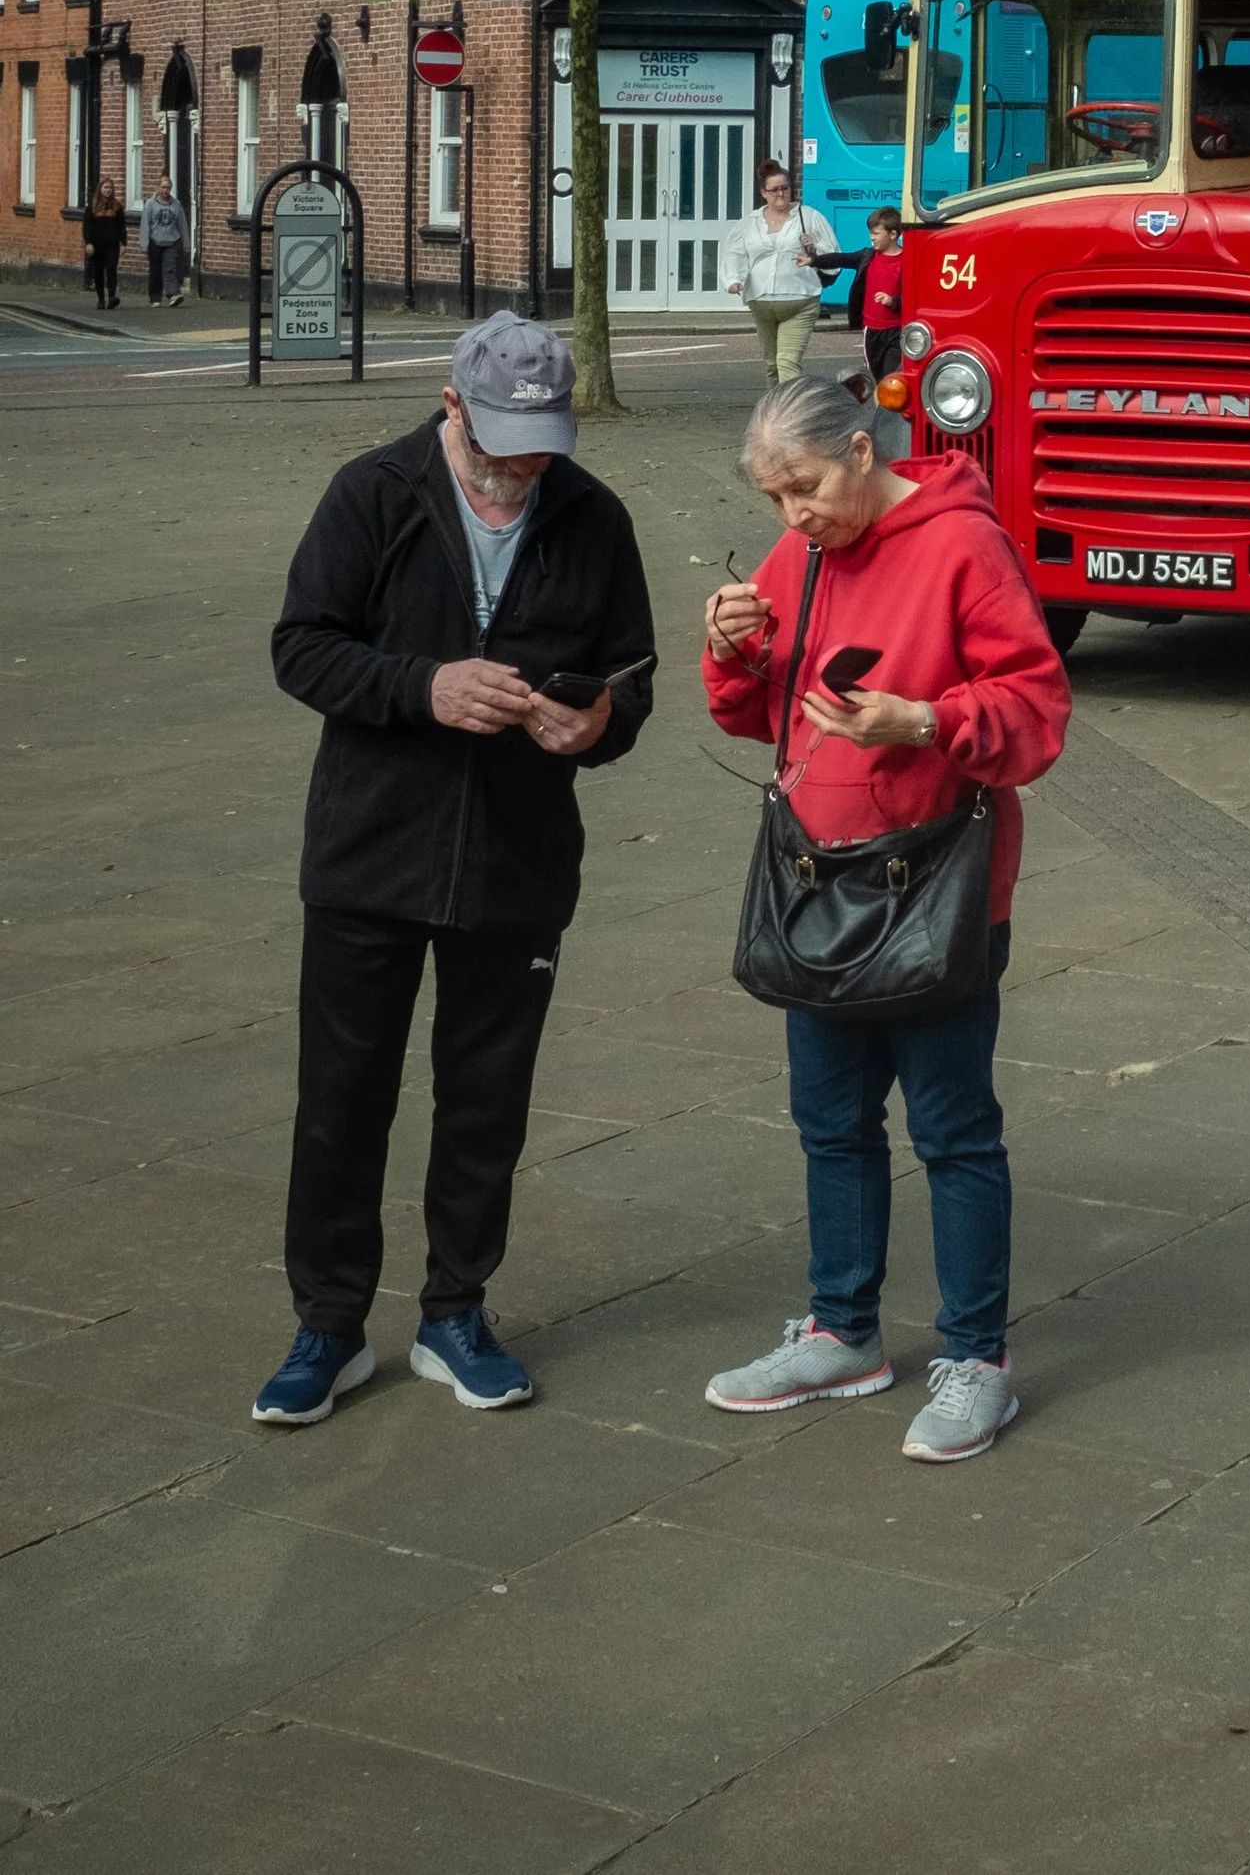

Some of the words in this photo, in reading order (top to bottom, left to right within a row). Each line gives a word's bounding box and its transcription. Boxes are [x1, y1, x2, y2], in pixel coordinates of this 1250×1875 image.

[639, 51, 699, 64] CARERS
[640, 65, 690, 77] TRUST
[622, 81, 631, 89] St
[661, 82, 687, 90] Carers
[689, 83, 715, 91] Centre
[616, 91, 651, 103] Carer
[654, 91, 723, 104] Clubhouse
[292, 194, 325, 203] Victoria
[293, 203, 324, 212] Square
[939, 254, 977, 290] 54
[282, 299, 333, 308] Pedestrian
[295, 309, 319, 318] Zone
[286, 321, 329, 334] ENDS
[1087, 551, 1145, 581] MDJ
